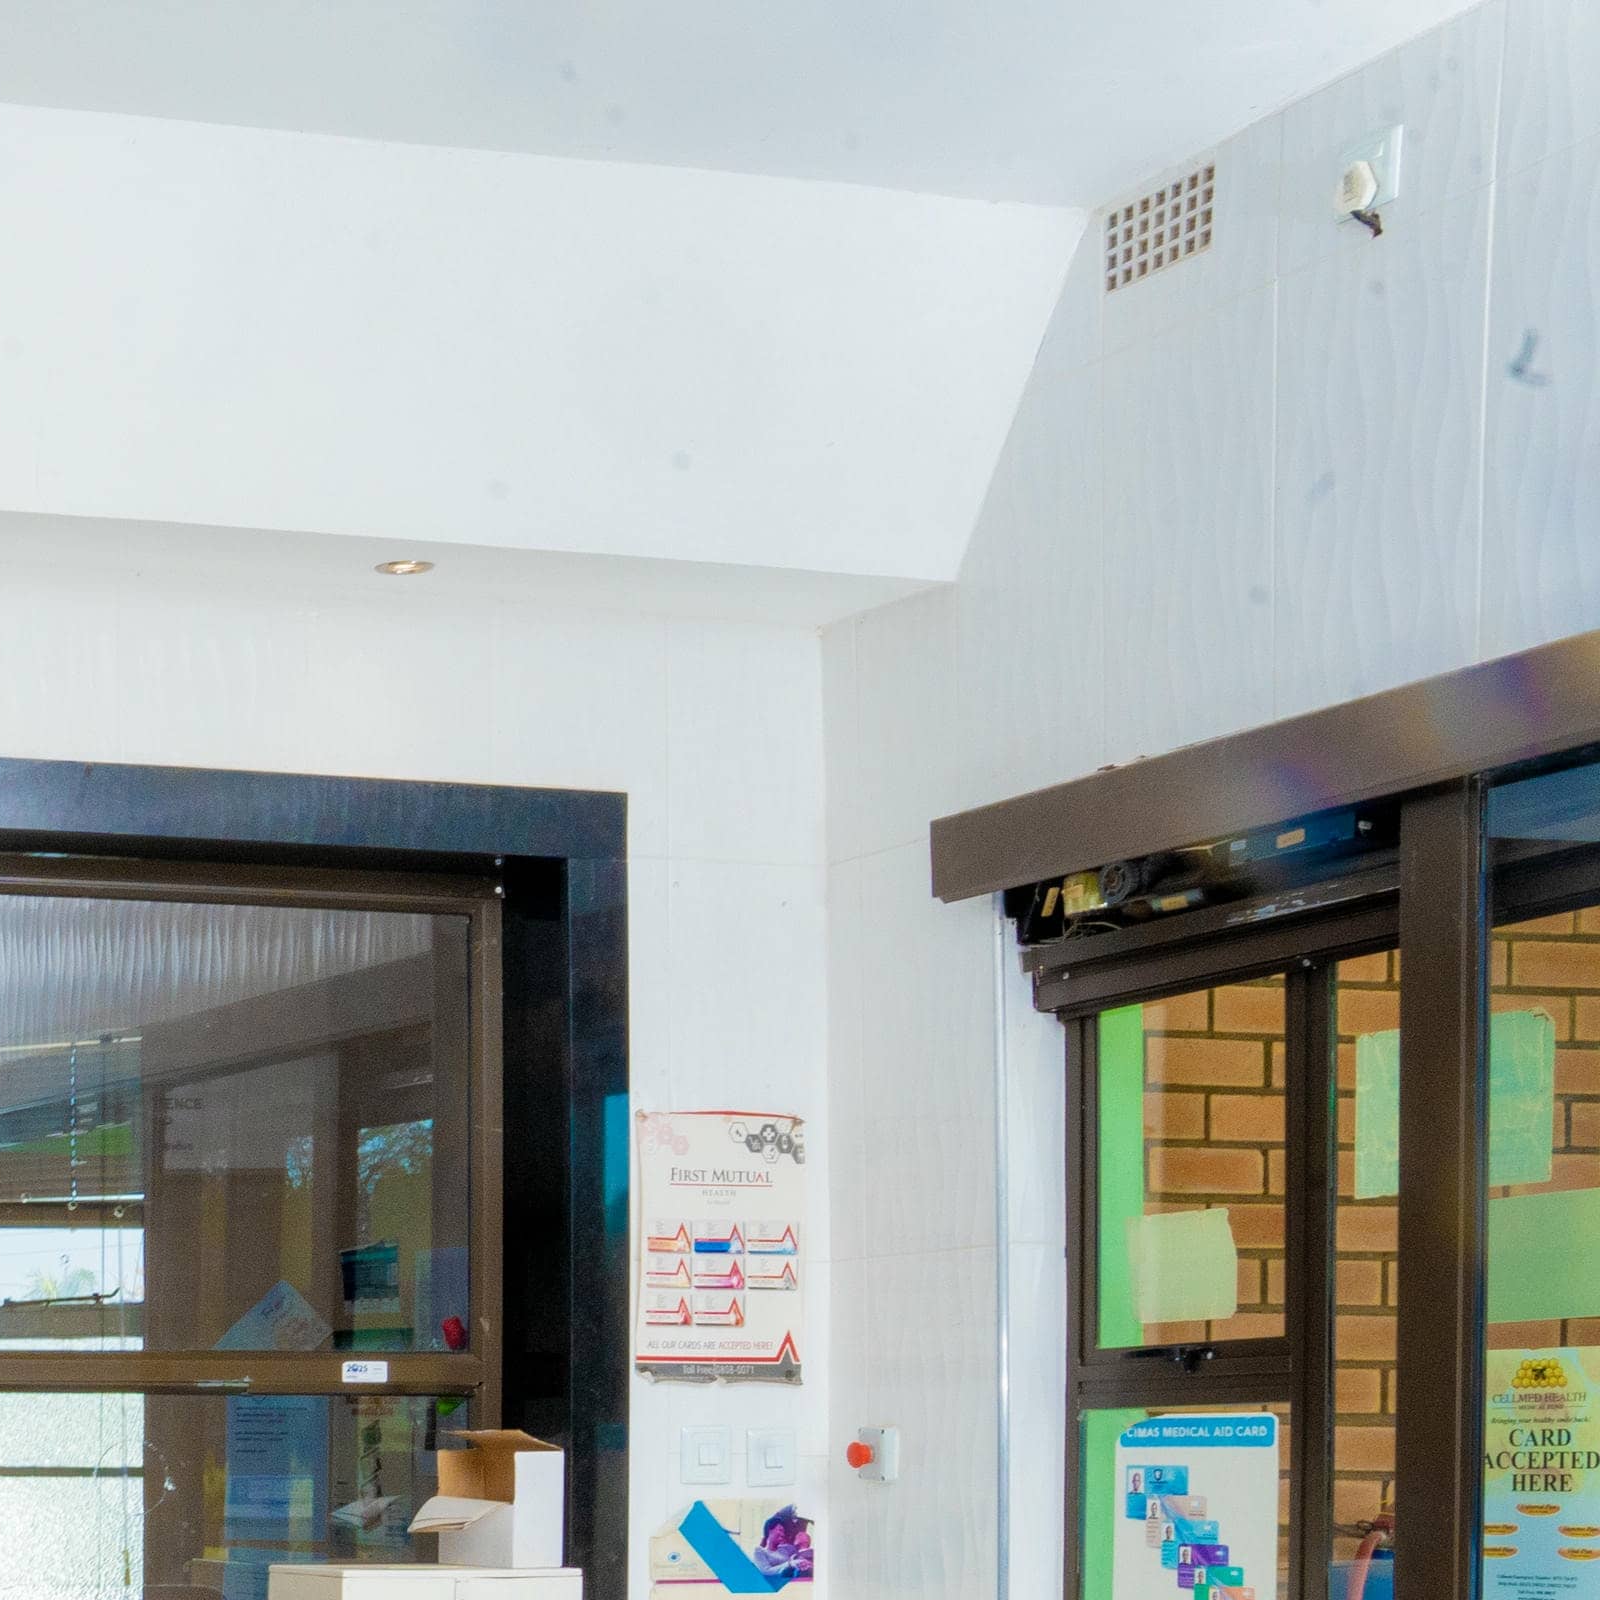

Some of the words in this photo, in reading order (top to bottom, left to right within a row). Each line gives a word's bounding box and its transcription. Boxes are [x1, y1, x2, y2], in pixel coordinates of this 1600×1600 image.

[1126, 1426, 1159, 1438] CIMAS
[1162, 1426, 1210, 1438] MEDICAL
[1213, 1426, 1234, 1437] AID
[1235, 1425, 1268, 1437] CARD
[1509, 1428, 1572, 1448] CARD
[1481, 1451, 1600, 1470] ACCEPTED
[1512, 1473, 1573, 1493] HERE
